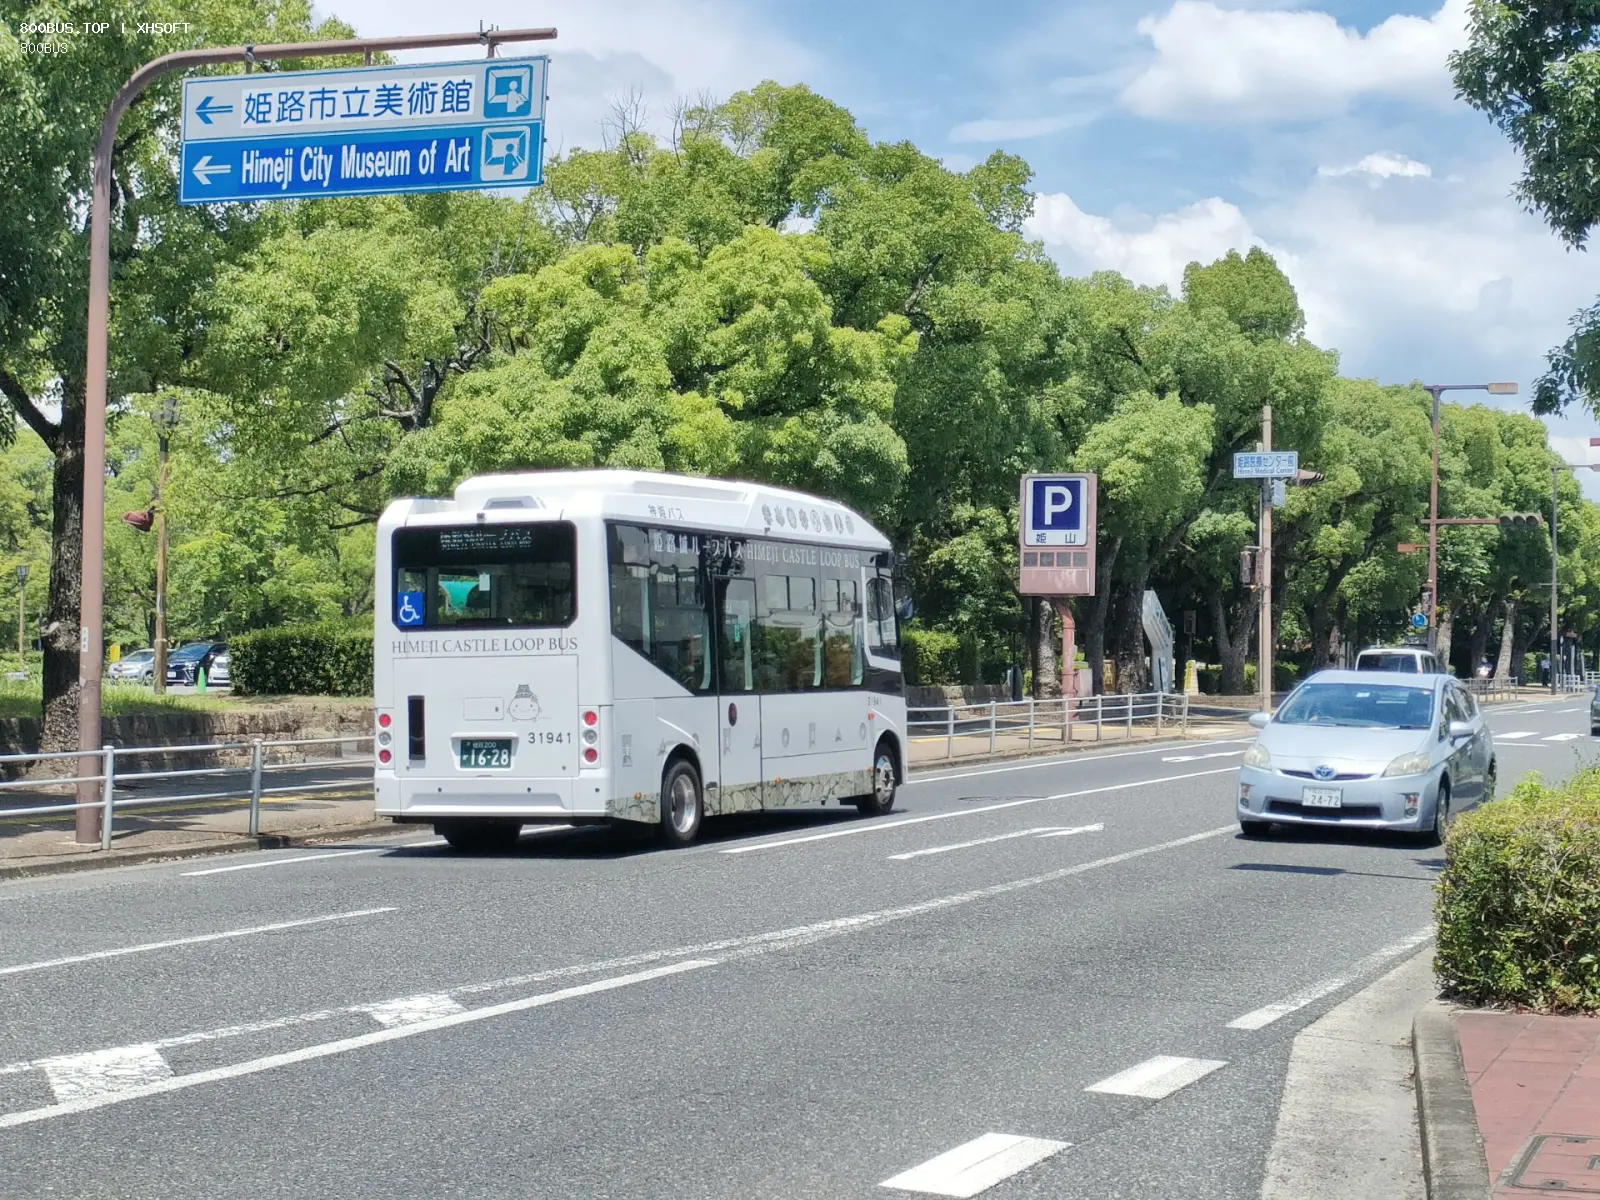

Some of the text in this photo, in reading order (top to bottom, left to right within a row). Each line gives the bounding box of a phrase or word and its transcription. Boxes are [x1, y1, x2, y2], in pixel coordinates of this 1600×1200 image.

[243, 78, 473, 125] 姫路市立美術館
[241, 137, 472, 190] Himeji City Museum of Art
[1275, 466, 1294, 474] Center
[1044, 485, 1073, 525] P
[747, 543, 860, 568] HIMEJI CASTLE LOOP BUS
[391, 636, 578, 655] HIMEJI CASTLE LOOP BUS
[528, 732, 571, 744] 31941
